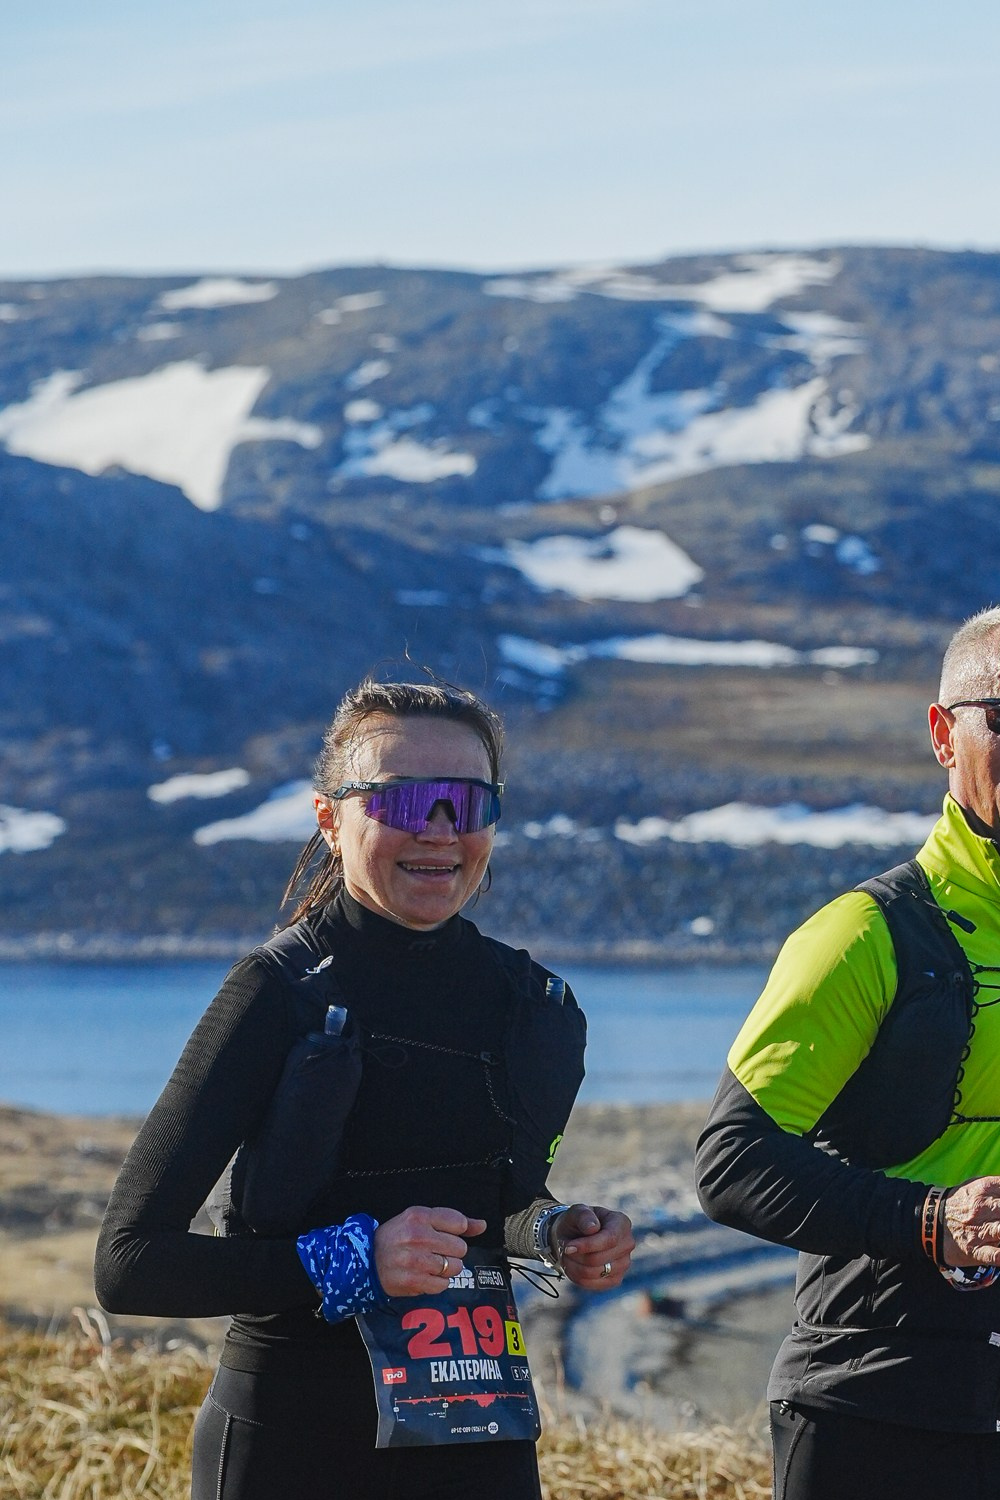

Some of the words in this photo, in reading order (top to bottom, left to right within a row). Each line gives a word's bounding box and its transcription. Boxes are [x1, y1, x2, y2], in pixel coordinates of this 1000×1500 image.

[491, 1270, 504, 1286] 50
[401, 1305, 505, 1360] 219
[512, 1327, 520, 1351] 3
[429, 1359, 503, 1383] ЕКАТЕРИНА
